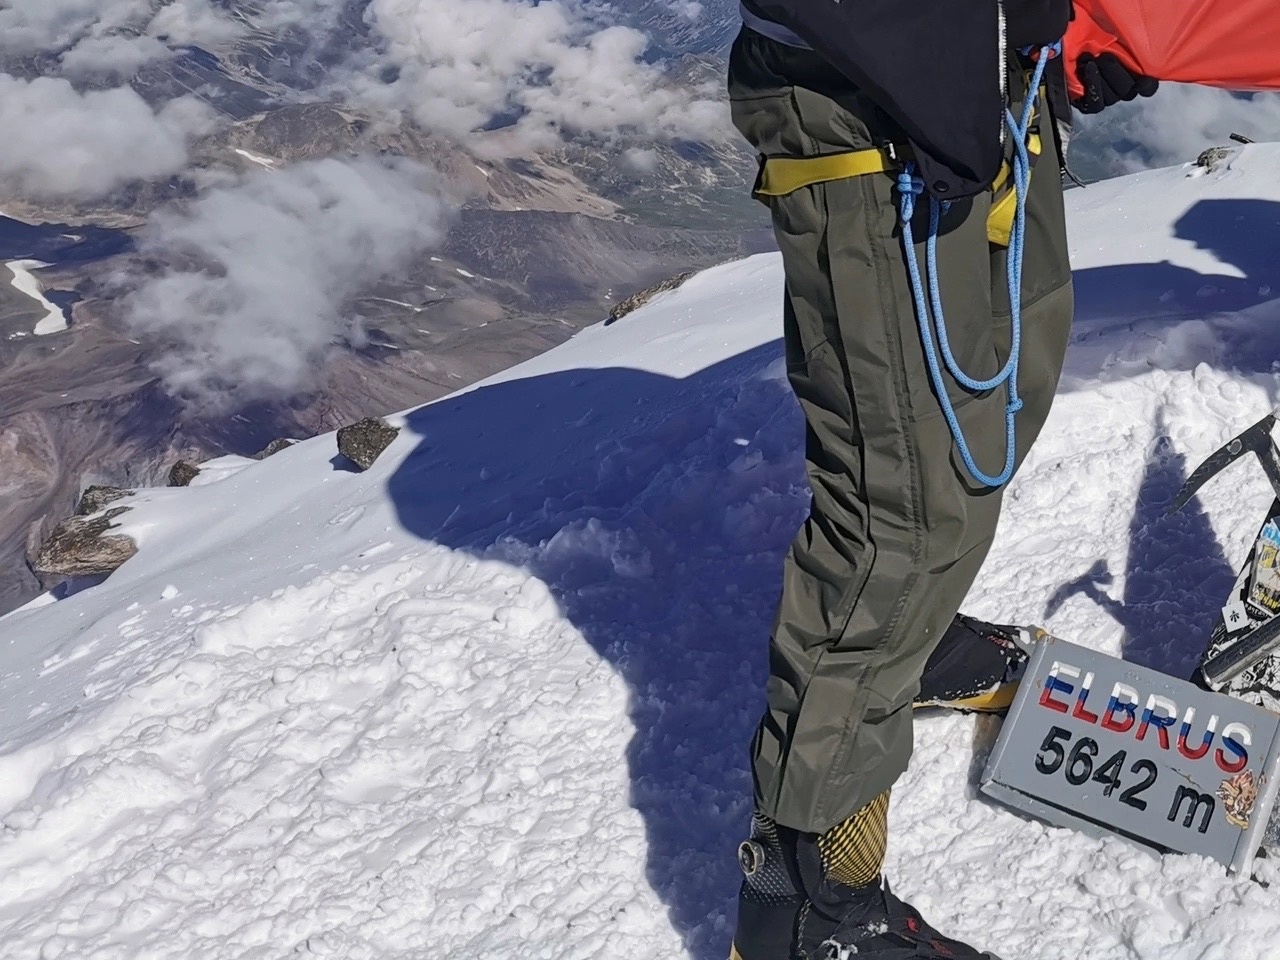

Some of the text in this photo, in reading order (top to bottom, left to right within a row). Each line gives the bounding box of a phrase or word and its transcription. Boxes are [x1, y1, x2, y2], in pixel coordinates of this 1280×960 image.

[1039, 660, 1252, 773] ELBRUS
[1035, 725, 1216, 834] 5642 m
